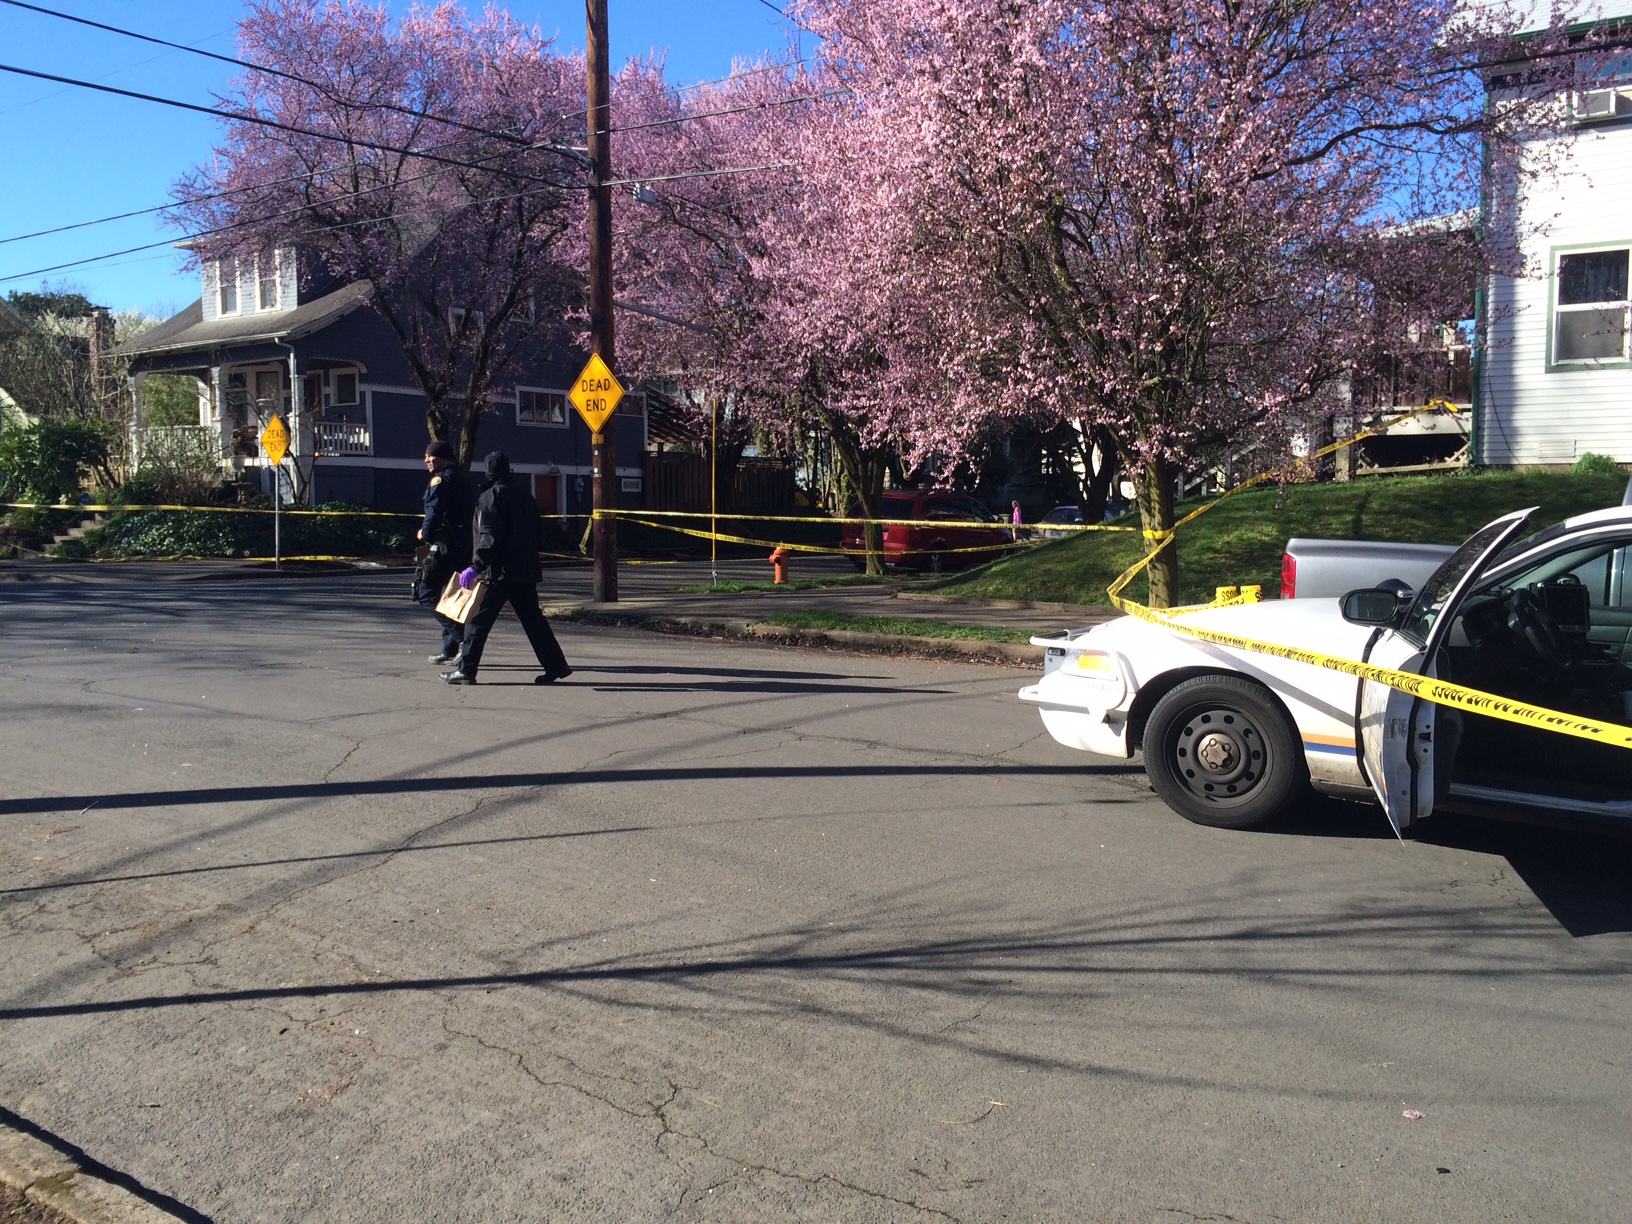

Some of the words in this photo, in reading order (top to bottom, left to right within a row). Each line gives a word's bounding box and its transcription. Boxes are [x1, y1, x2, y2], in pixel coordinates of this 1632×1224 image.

[582, 379, 610, 392] DEAD
[586, 399, 606, 411] END
[268, 430, 284, 438] DEAD
[270, 443, 282, 452] END
